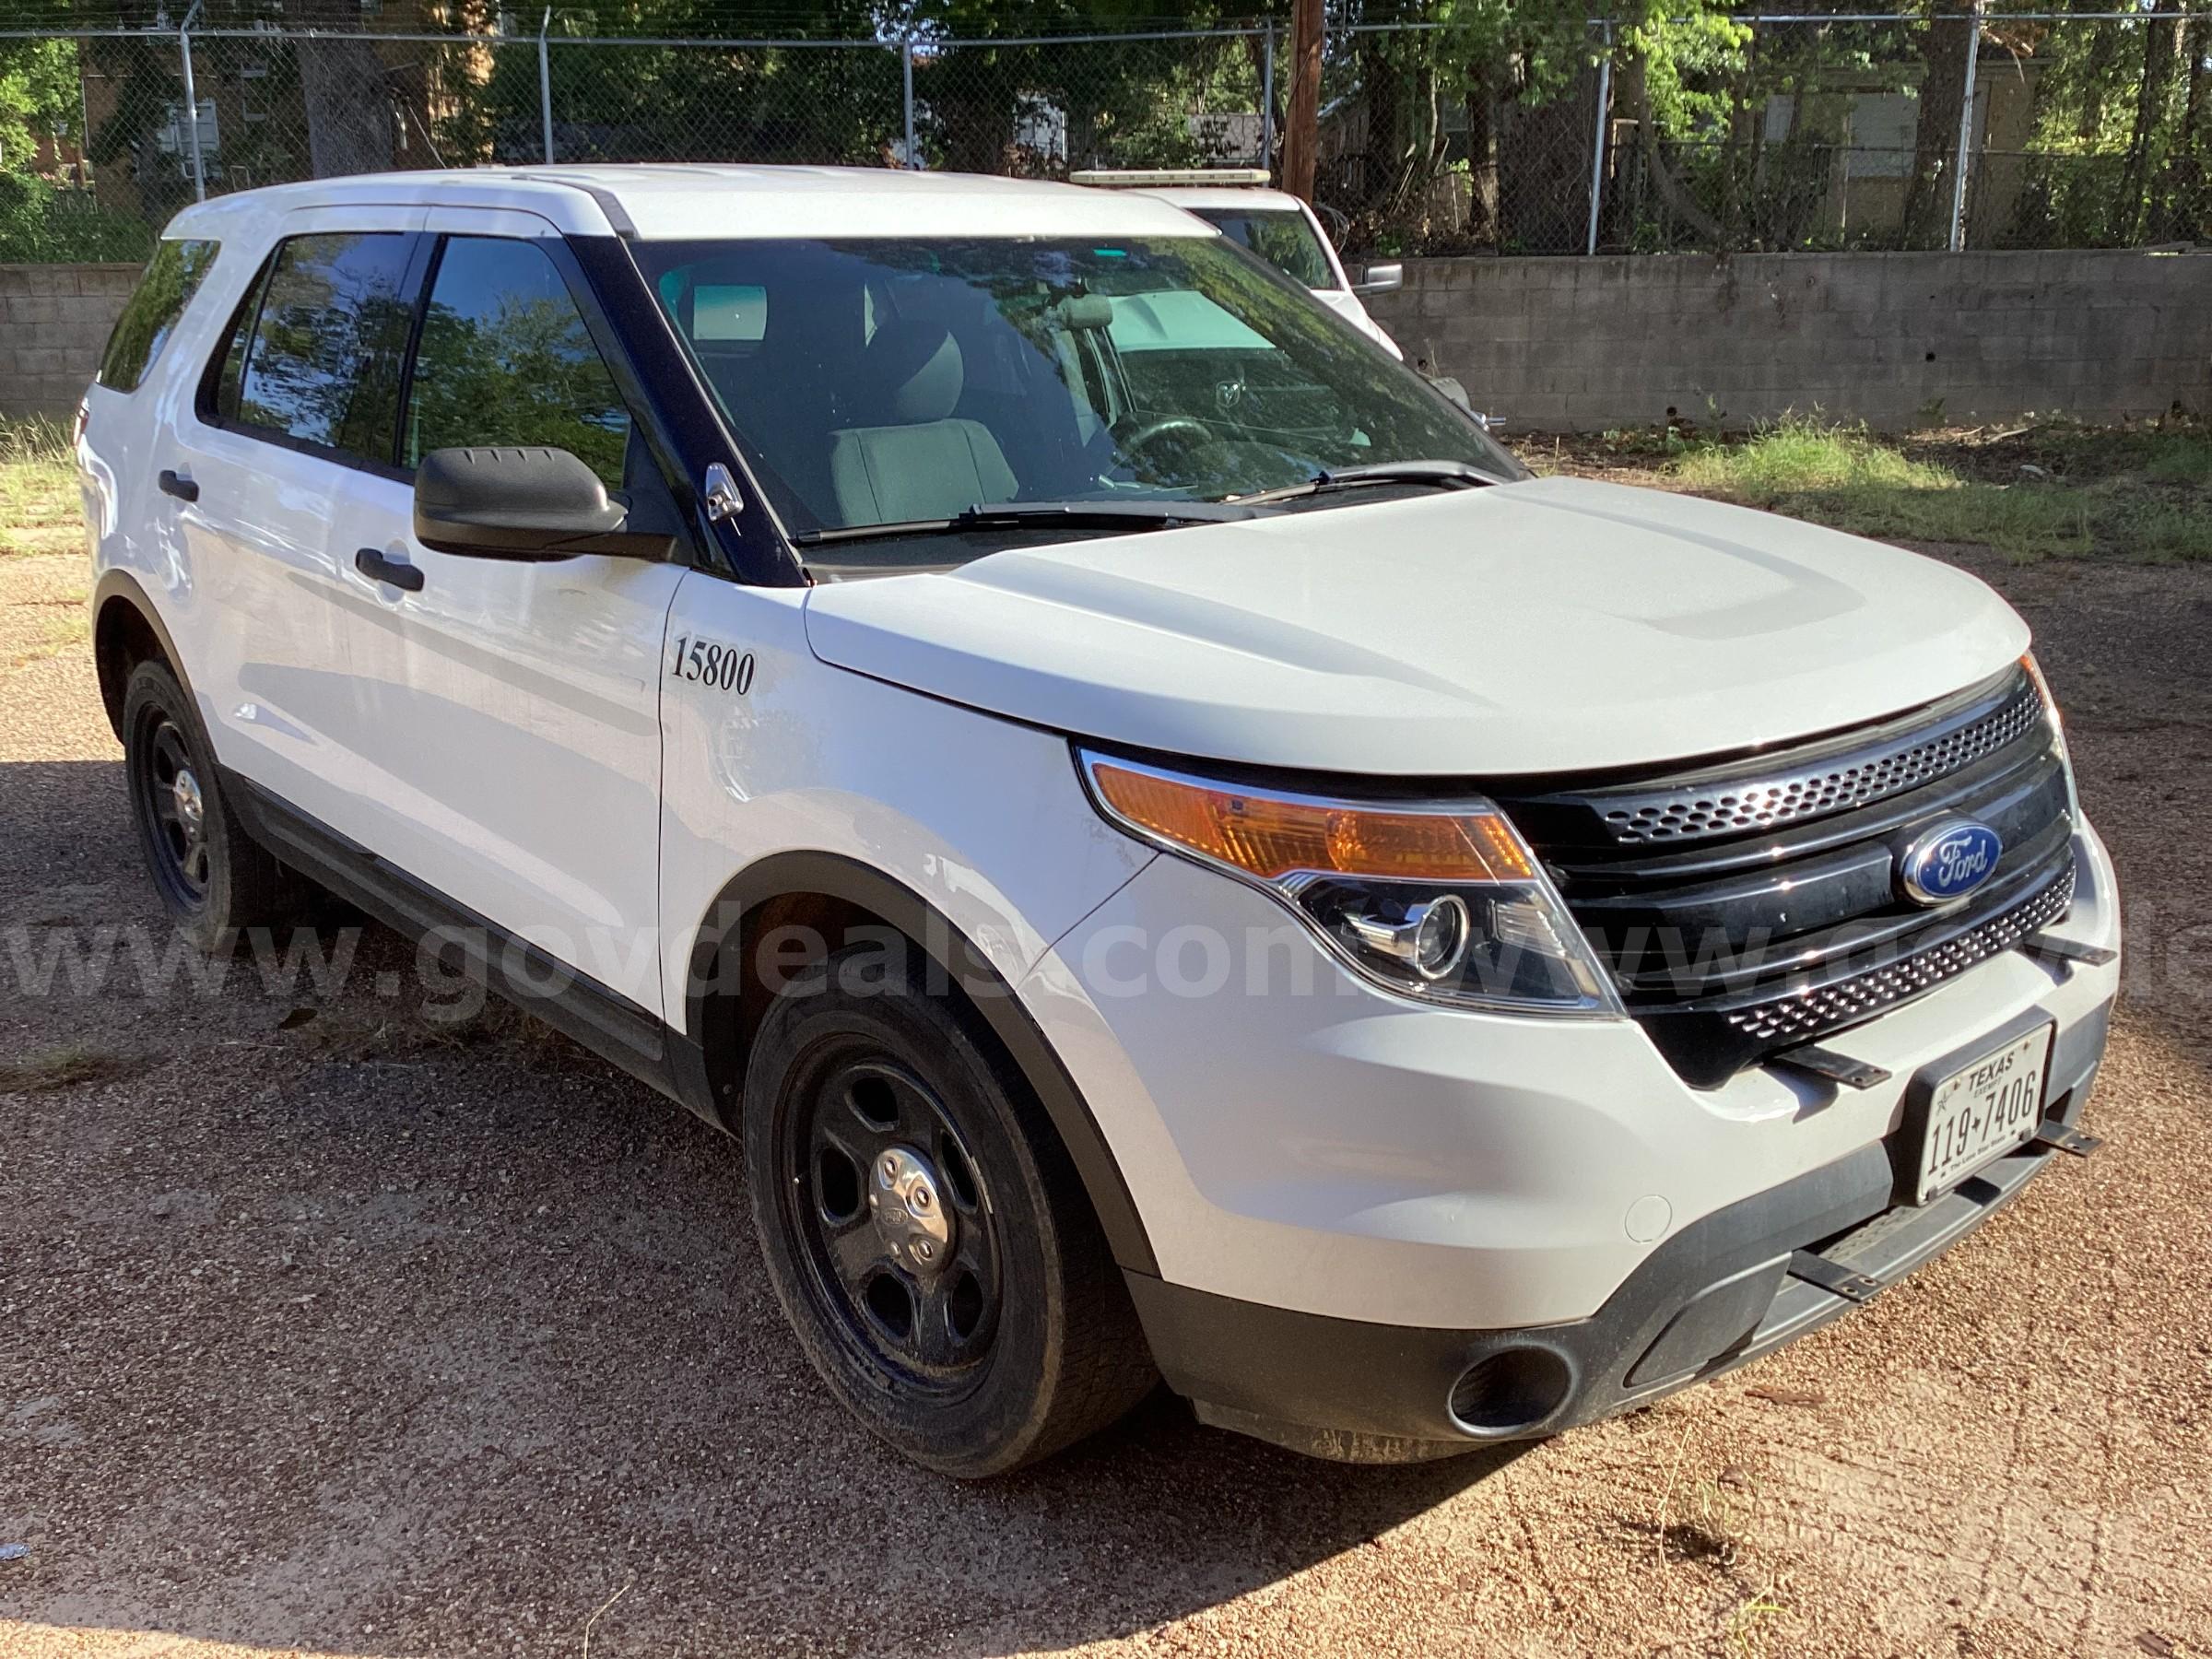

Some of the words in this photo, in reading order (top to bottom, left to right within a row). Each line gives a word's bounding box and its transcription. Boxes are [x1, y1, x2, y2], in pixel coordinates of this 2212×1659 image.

[672, 636, 755, 696] 15800
[1938, 835, 1988, 888] Ford
[1969, 1051, 2015, 1091] TEXAS
